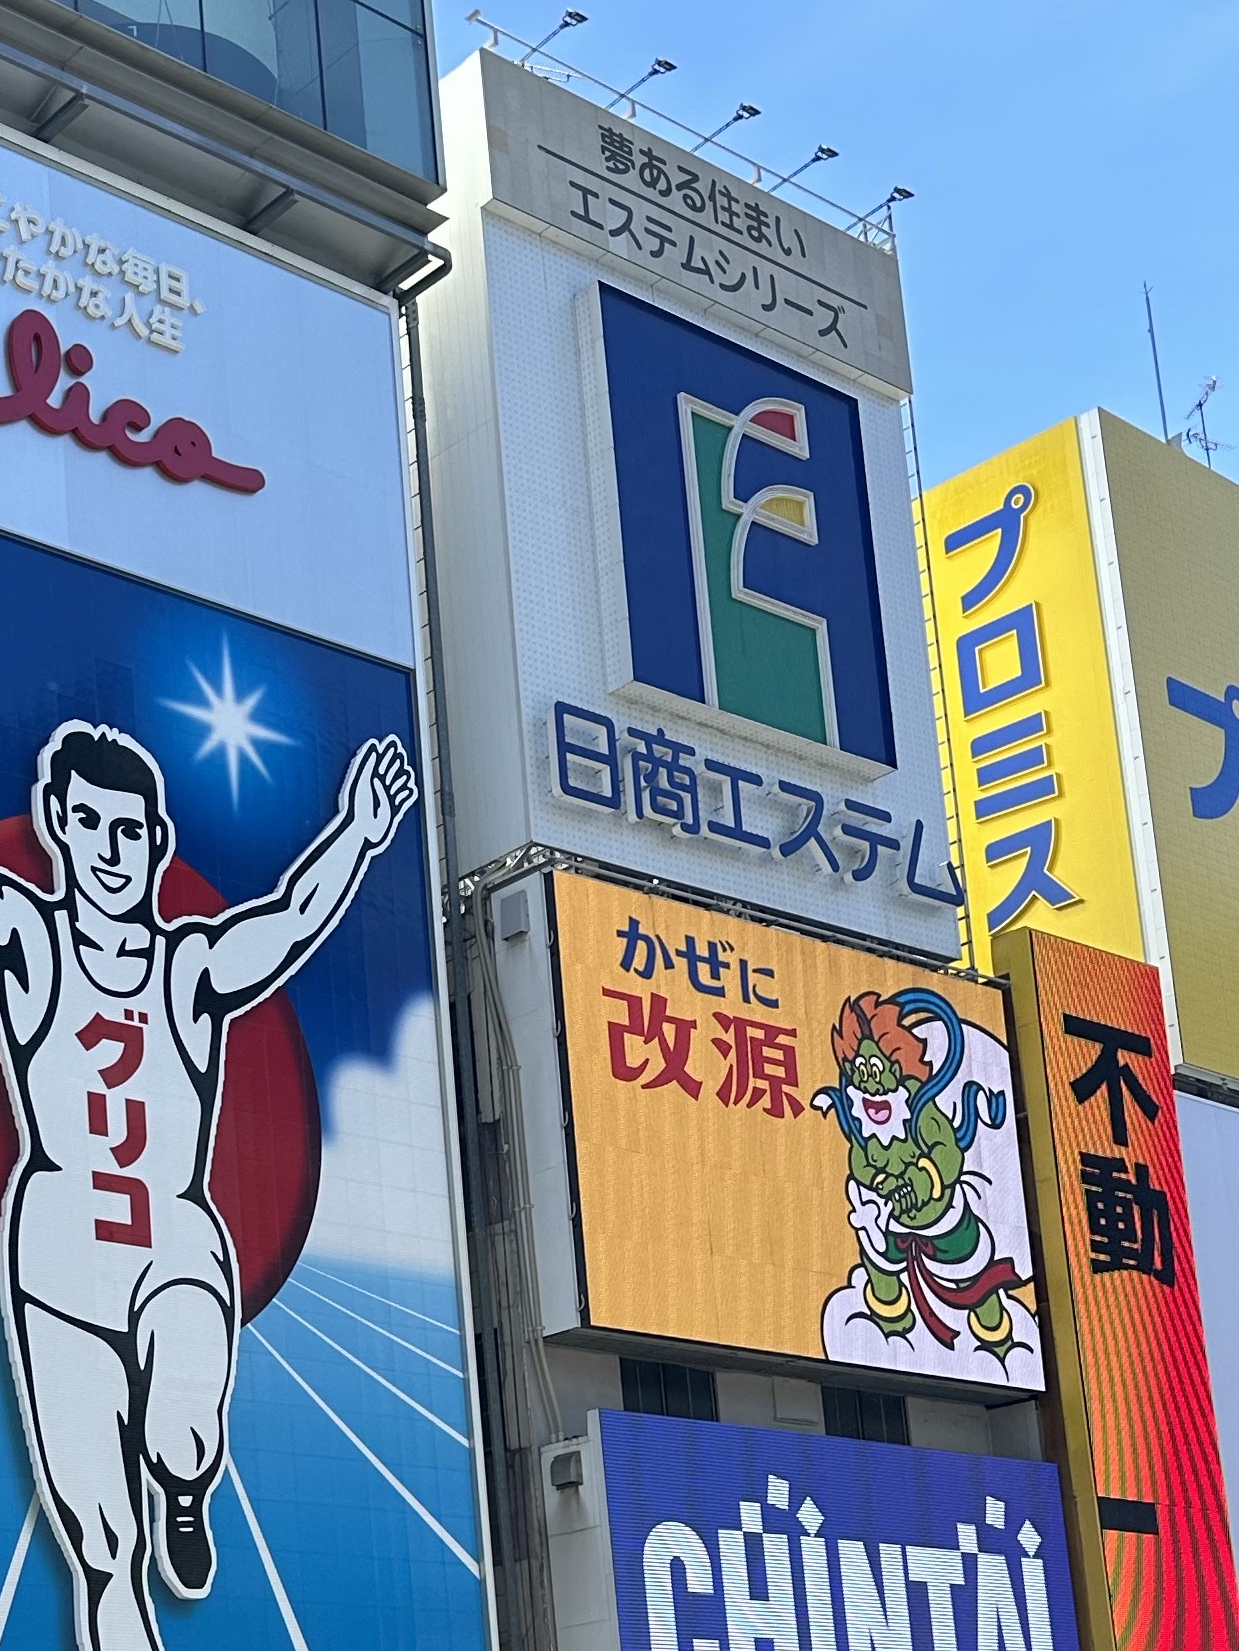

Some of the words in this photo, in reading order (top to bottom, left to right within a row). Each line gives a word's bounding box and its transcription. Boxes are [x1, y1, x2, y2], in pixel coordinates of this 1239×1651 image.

[568, 180, 849, 350] エステムシリーズ
[597, 123, 807, 260] 夢ある住まい
[943, 482, 1084, 932] プロミス
[554, 700, 963, 908] 日商エステム
[616, 915, 781, 1010] かぜに
[75, 1008, 152, 1249] グリコ
[601, 986, 805, 1120] 改源
